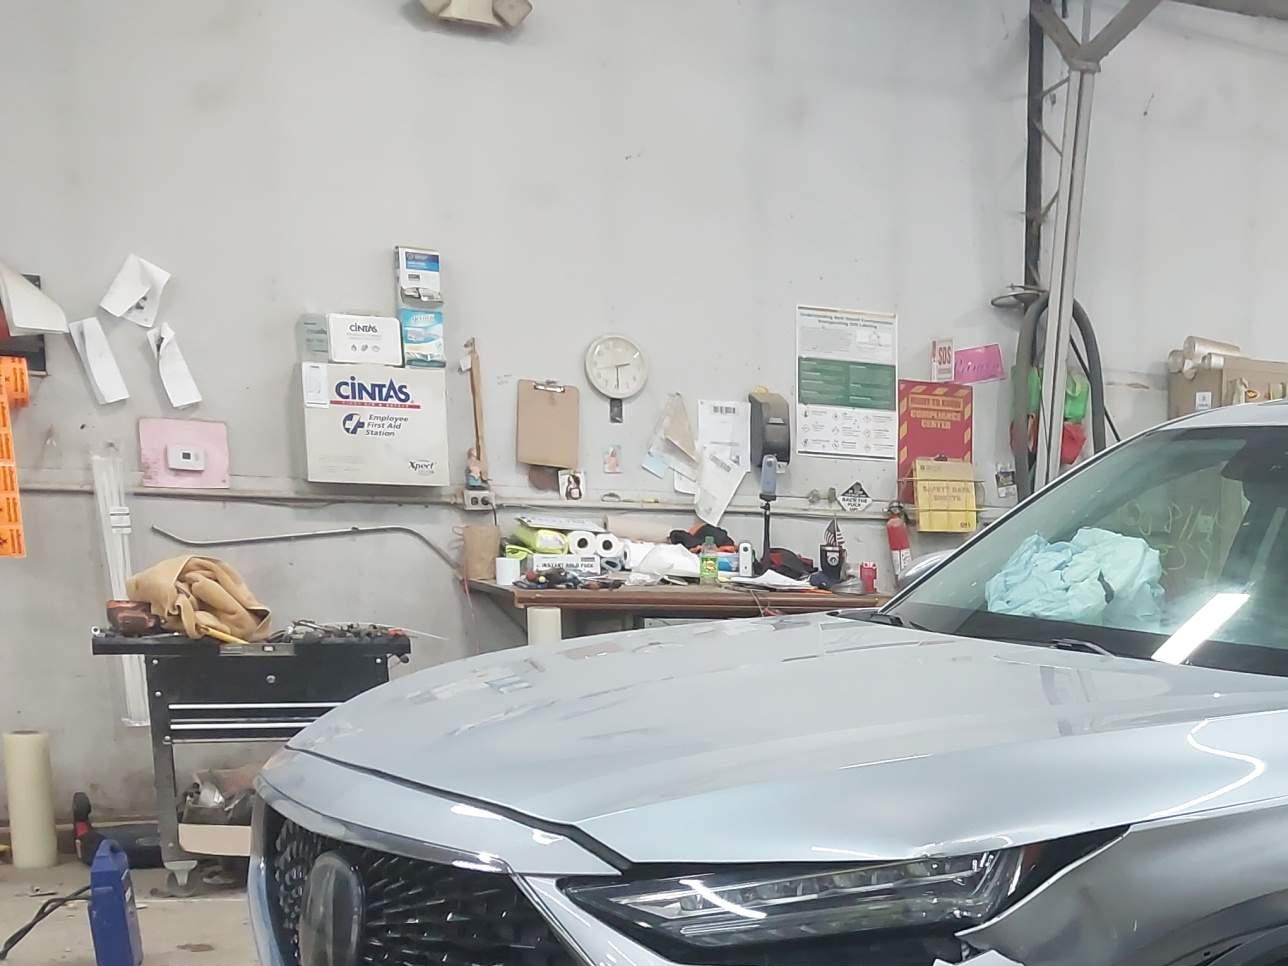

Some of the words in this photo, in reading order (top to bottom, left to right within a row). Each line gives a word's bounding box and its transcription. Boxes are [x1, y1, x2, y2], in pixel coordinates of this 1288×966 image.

[349, 322, 378, 333] CINTAS
[335, 376, 410, 403] CINTAS
[369, 414, 408, 422] Employee
